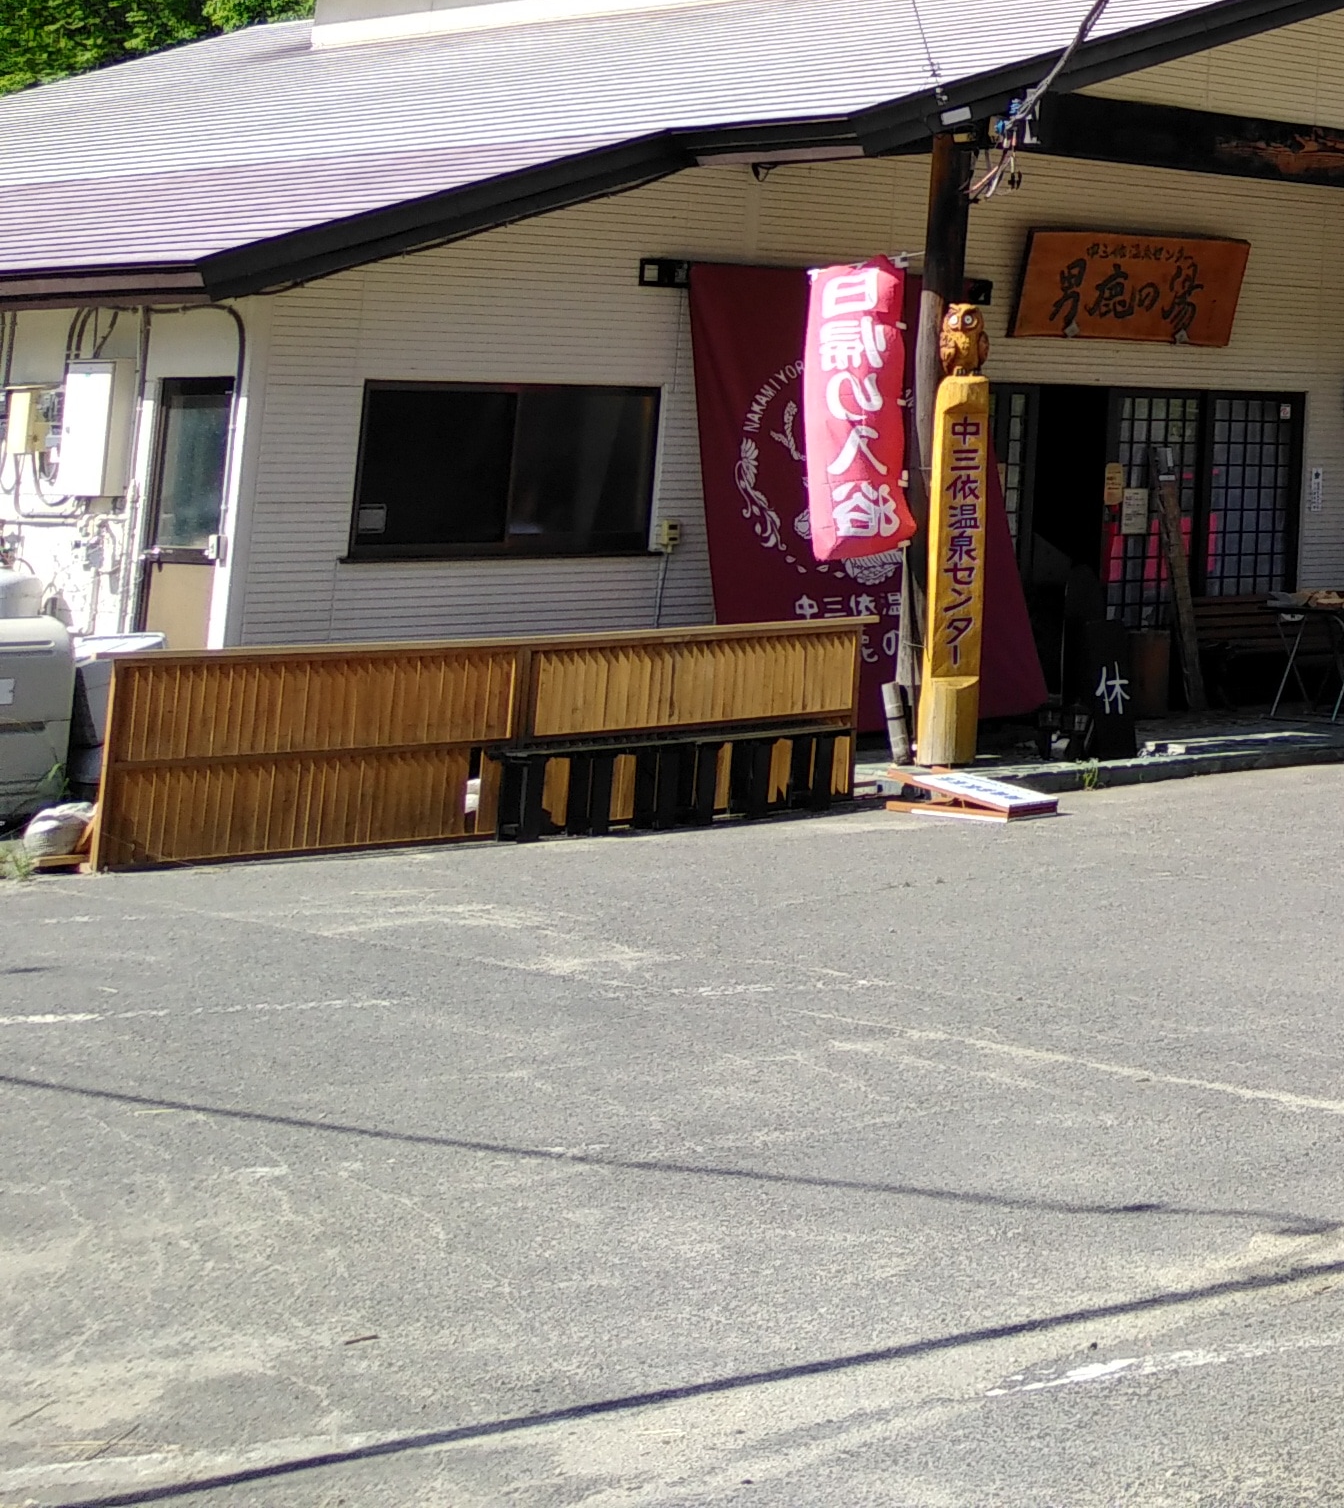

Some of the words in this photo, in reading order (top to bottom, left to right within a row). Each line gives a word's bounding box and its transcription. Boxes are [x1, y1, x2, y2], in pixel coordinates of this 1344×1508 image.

[1049, 258, 1204, 335] 男鹿の湯
[944, 415, 981, 666] 中三依温泉センター
[1095, 661, 1130, 714] 休
